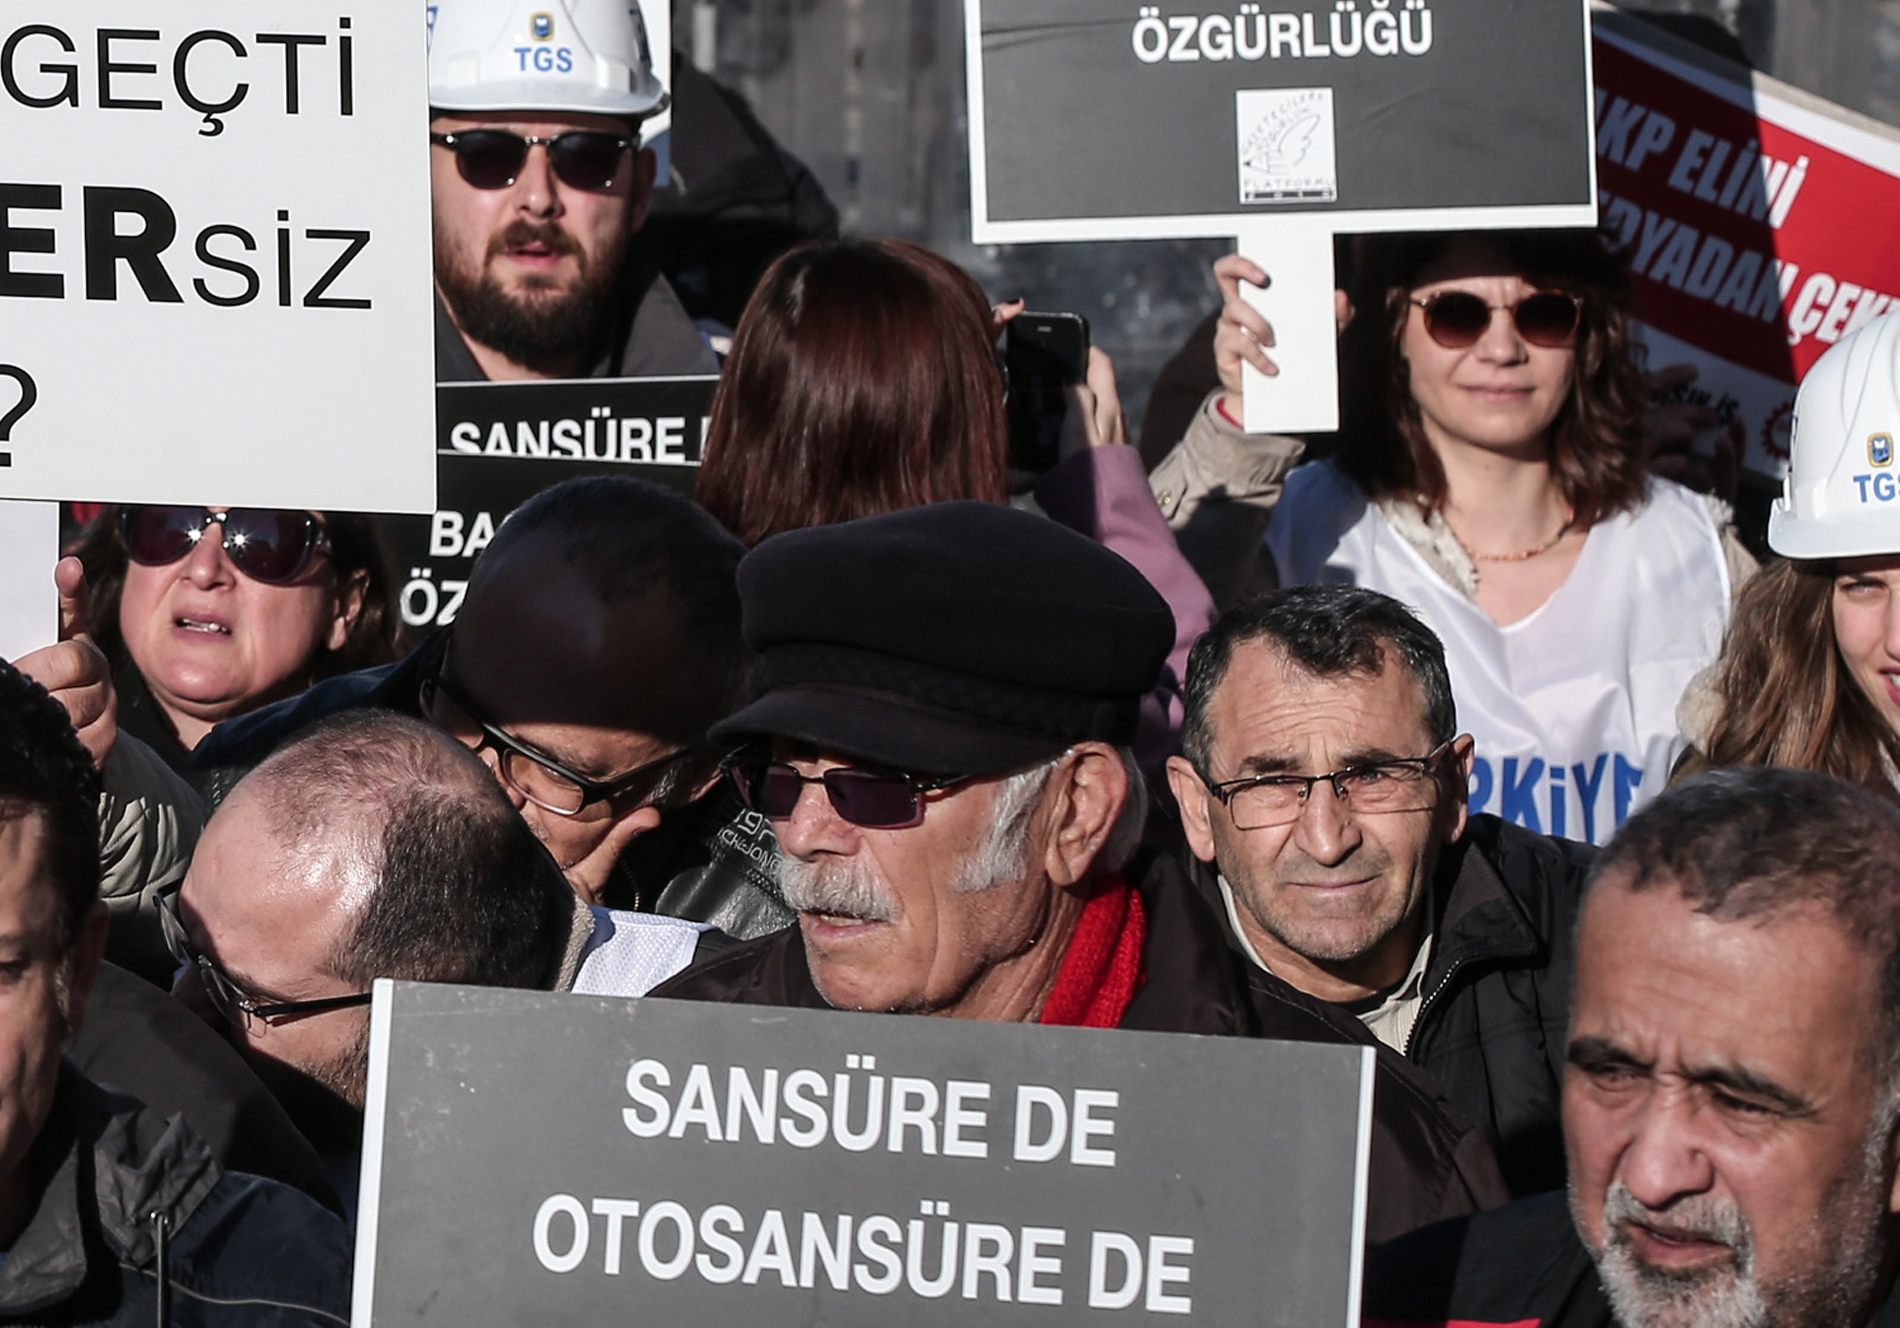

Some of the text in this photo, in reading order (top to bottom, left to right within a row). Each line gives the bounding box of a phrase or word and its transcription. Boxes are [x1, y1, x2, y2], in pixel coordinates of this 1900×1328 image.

[0, 15, 355, 138] GEÇTİ
[513, 46, 574, 73] TGS
[1667, 128, 1810, 230] ELİNİ
[450, 406, 686, 463] SANSÜRE
[621, 1053, 1120, 1168] SANSÜRE DE
[532, 1193, 1195, 1315] OTOSANSÜRE DE
